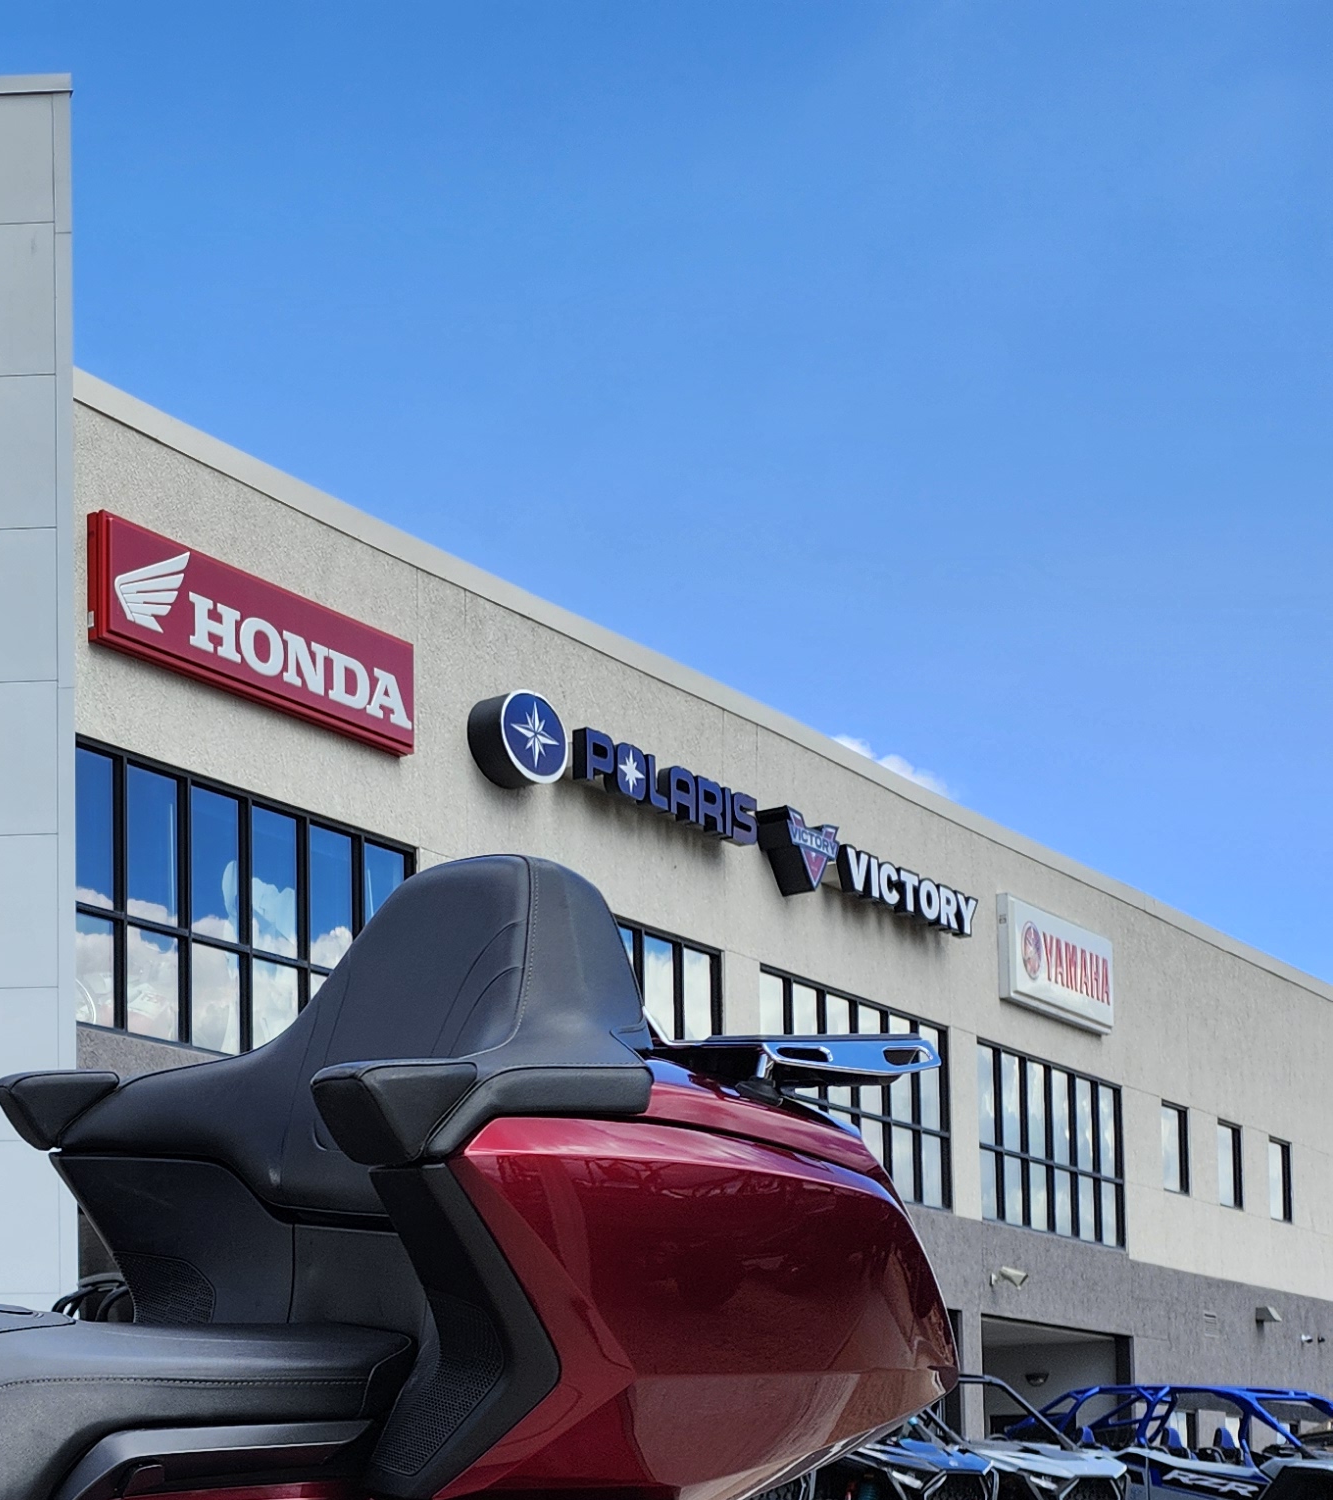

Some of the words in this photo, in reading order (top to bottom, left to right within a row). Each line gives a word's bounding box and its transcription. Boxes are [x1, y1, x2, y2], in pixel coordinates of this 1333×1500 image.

[188, 591, 412, 730] HONDA
[578, 728, 758, 845] POLARIS
[791, 824, 837, 854] VICTORY
[842, 844, 978, 937] VICTORY
[1041, 930, 1111, 1007] YAMAHA
[1162, 1469, 1260, 1499] RZR
